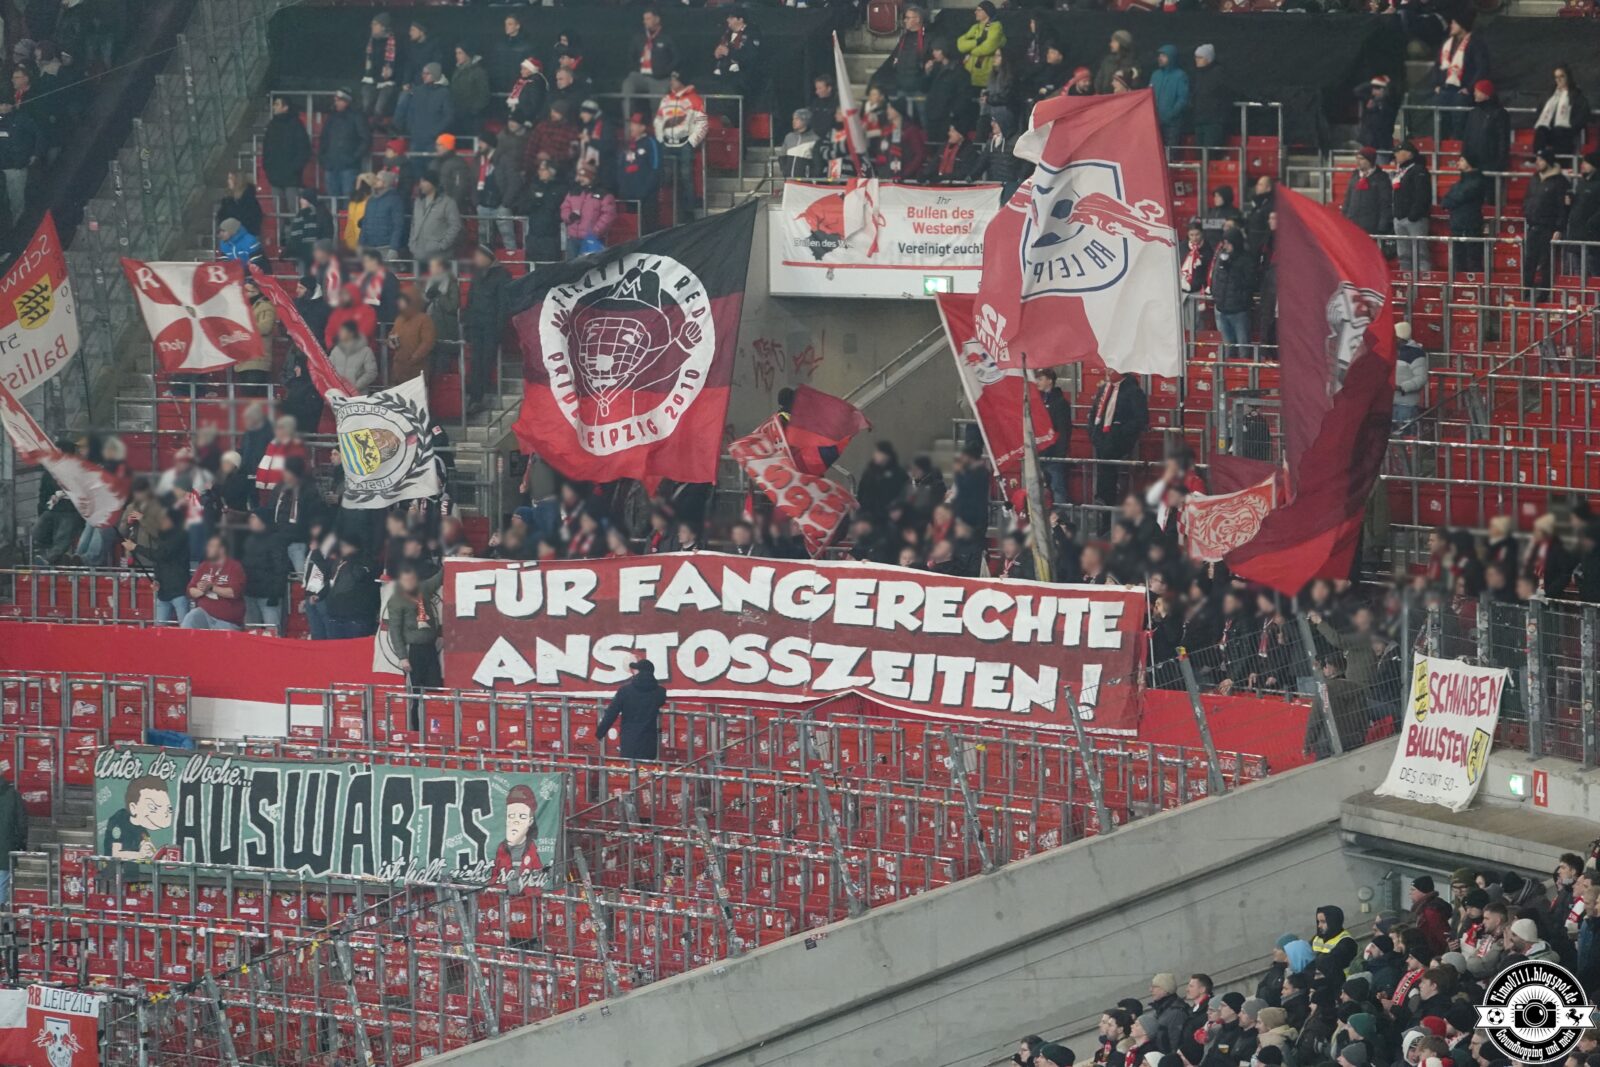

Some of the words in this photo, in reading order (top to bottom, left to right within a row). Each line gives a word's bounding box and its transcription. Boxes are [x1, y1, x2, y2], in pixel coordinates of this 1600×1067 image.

[907, 207, 947, 219] Bullen
[952, 207, 974, 219] des
[937, 196, 952, 205] Ihr
[913, 222, 973, 234] Westens!
[898, 243, 951, 257] Vereinigt
[953, 243, 984, 255] euch!
[674, 275, 706, 319] RED
[583, 418, 659, 449] EIPZIG
[664, 368, 701, 421] 2010
[455, 561, 598, 617] FÜR
[618, 560, 1125, 649] FANGERECHTE
[472, 629, 1059, 713] ANSTOSSZEITEN
[1429, 671, 1503, 717] SCHWABEN
[1406, 723, 1470, 767] BALLISTEN
[94, 749, 143, 779] Unter
[148, 751, 176, 780] der
[182, 753, 253, 787] Woche...
[1399, 766, 1416, 784] DES
[1535, 774, 1545, 803] 4
[174, 763, 493, 877] AUSWÄRTS
[28, 985, 42, 1006] RB
[44, 988, 95, 1014] LEIPZIG
